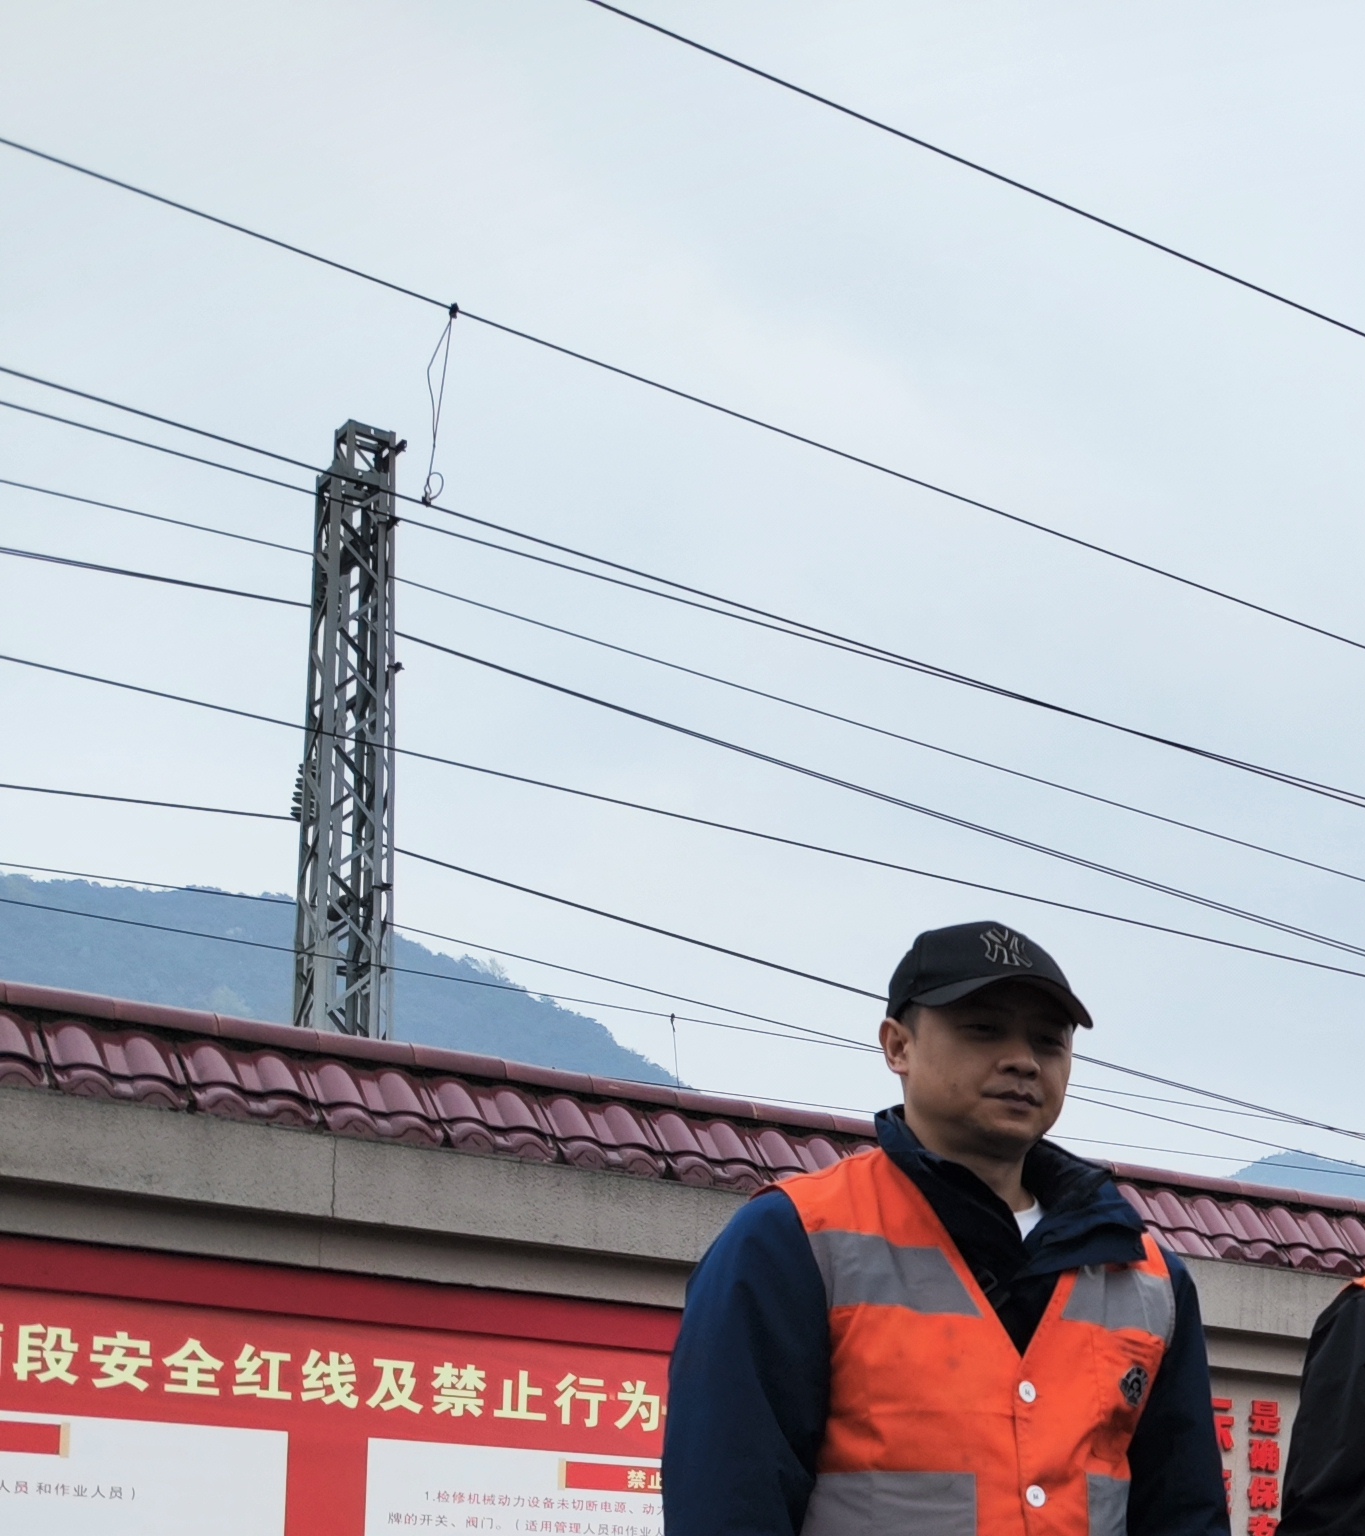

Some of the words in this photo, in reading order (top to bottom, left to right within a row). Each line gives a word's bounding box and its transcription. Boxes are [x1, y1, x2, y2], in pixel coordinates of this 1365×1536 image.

[0, 1323, 664, 1433] 段安全红线及禁止行为
